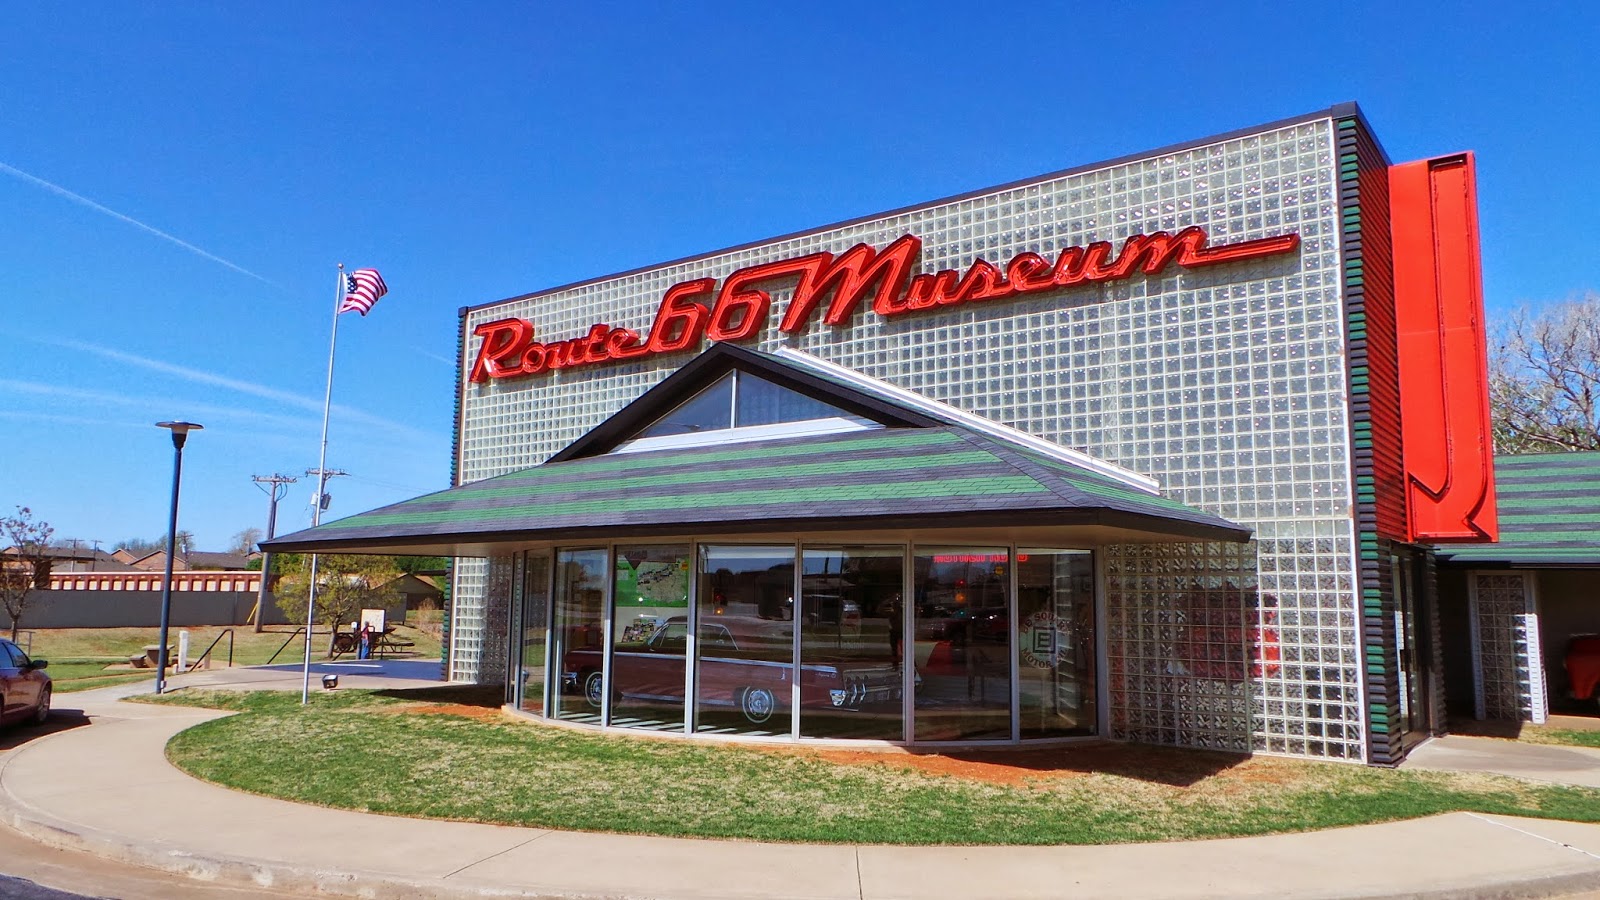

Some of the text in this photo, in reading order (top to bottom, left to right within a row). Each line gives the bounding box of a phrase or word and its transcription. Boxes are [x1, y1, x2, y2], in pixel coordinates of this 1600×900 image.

[469, 226, 1300, 383] Route 66 Museum
[1022, 648, 1053, 668] MOTOR
